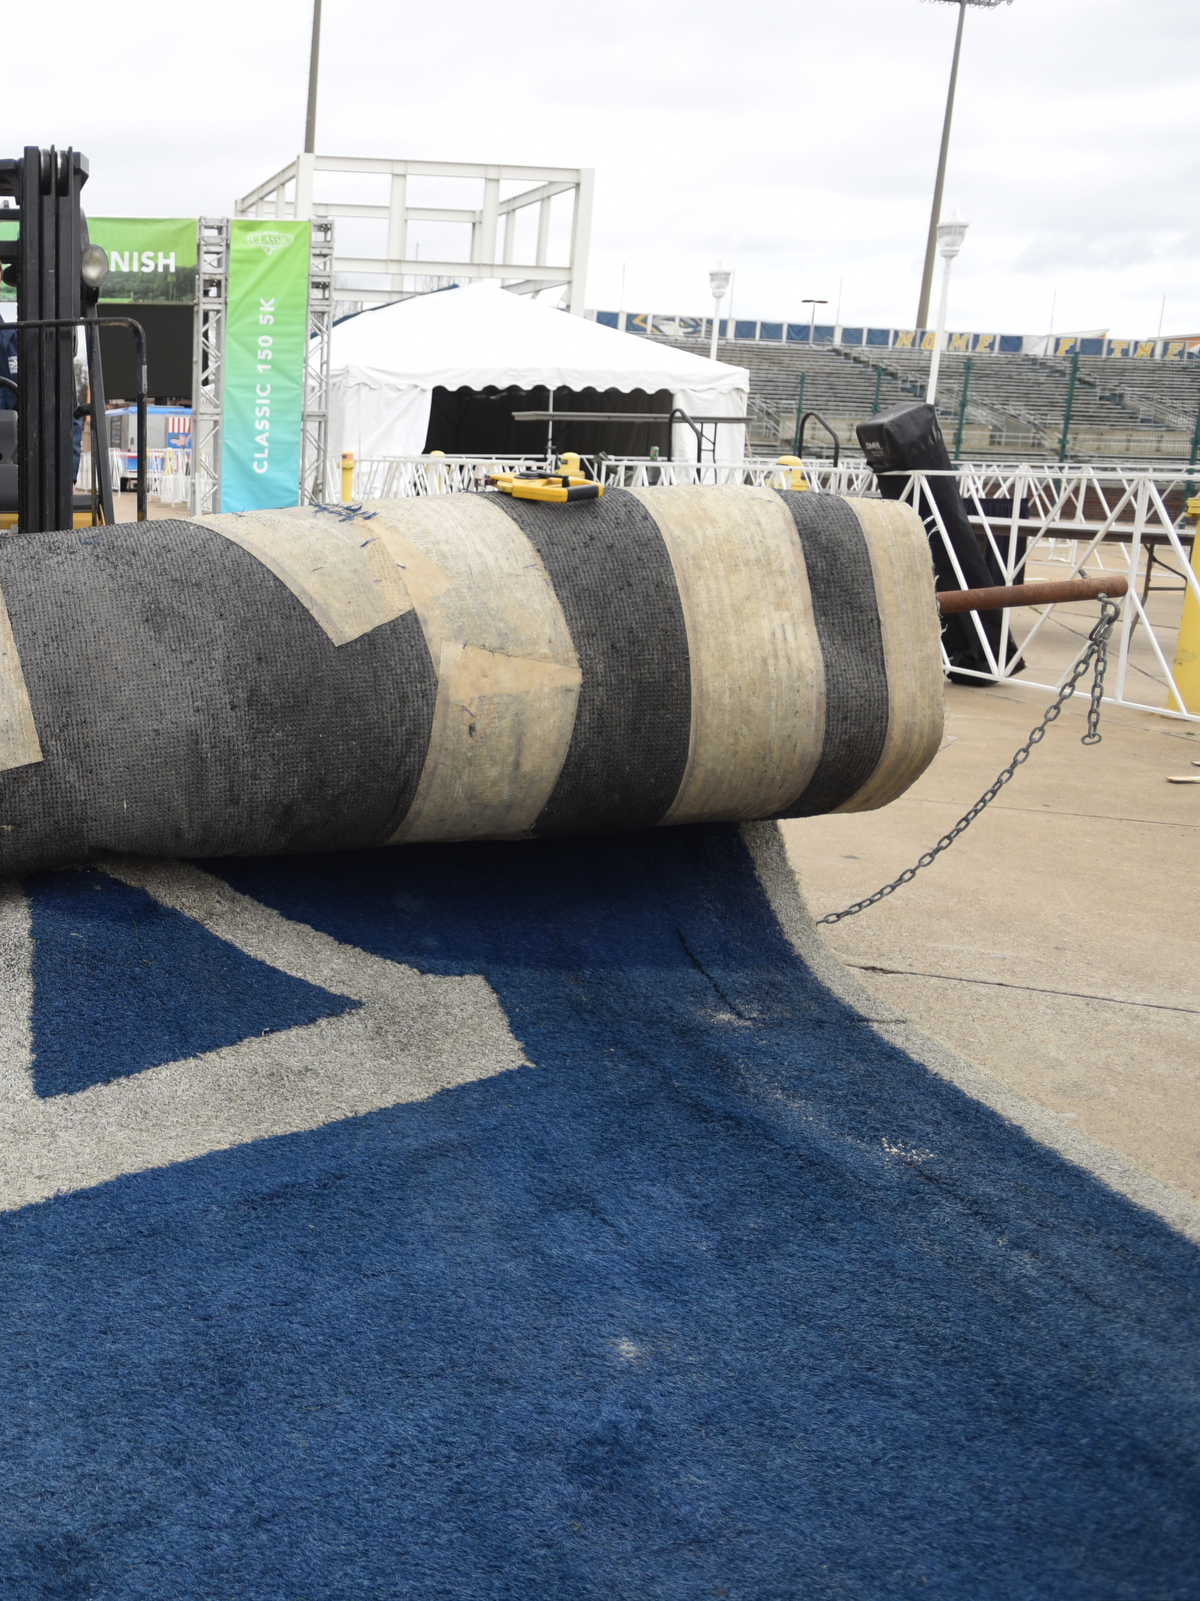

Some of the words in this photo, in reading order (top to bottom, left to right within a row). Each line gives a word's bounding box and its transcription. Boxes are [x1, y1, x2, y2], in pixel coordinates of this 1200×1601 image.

[250, 233, 291, 244] CLASSIC
[110, 251, 176, 273] NISH
[259, 297, 275, 325] 5K
[257, 335, 273, 373] 150
[253, 383, 271, 474] CLASSIC
